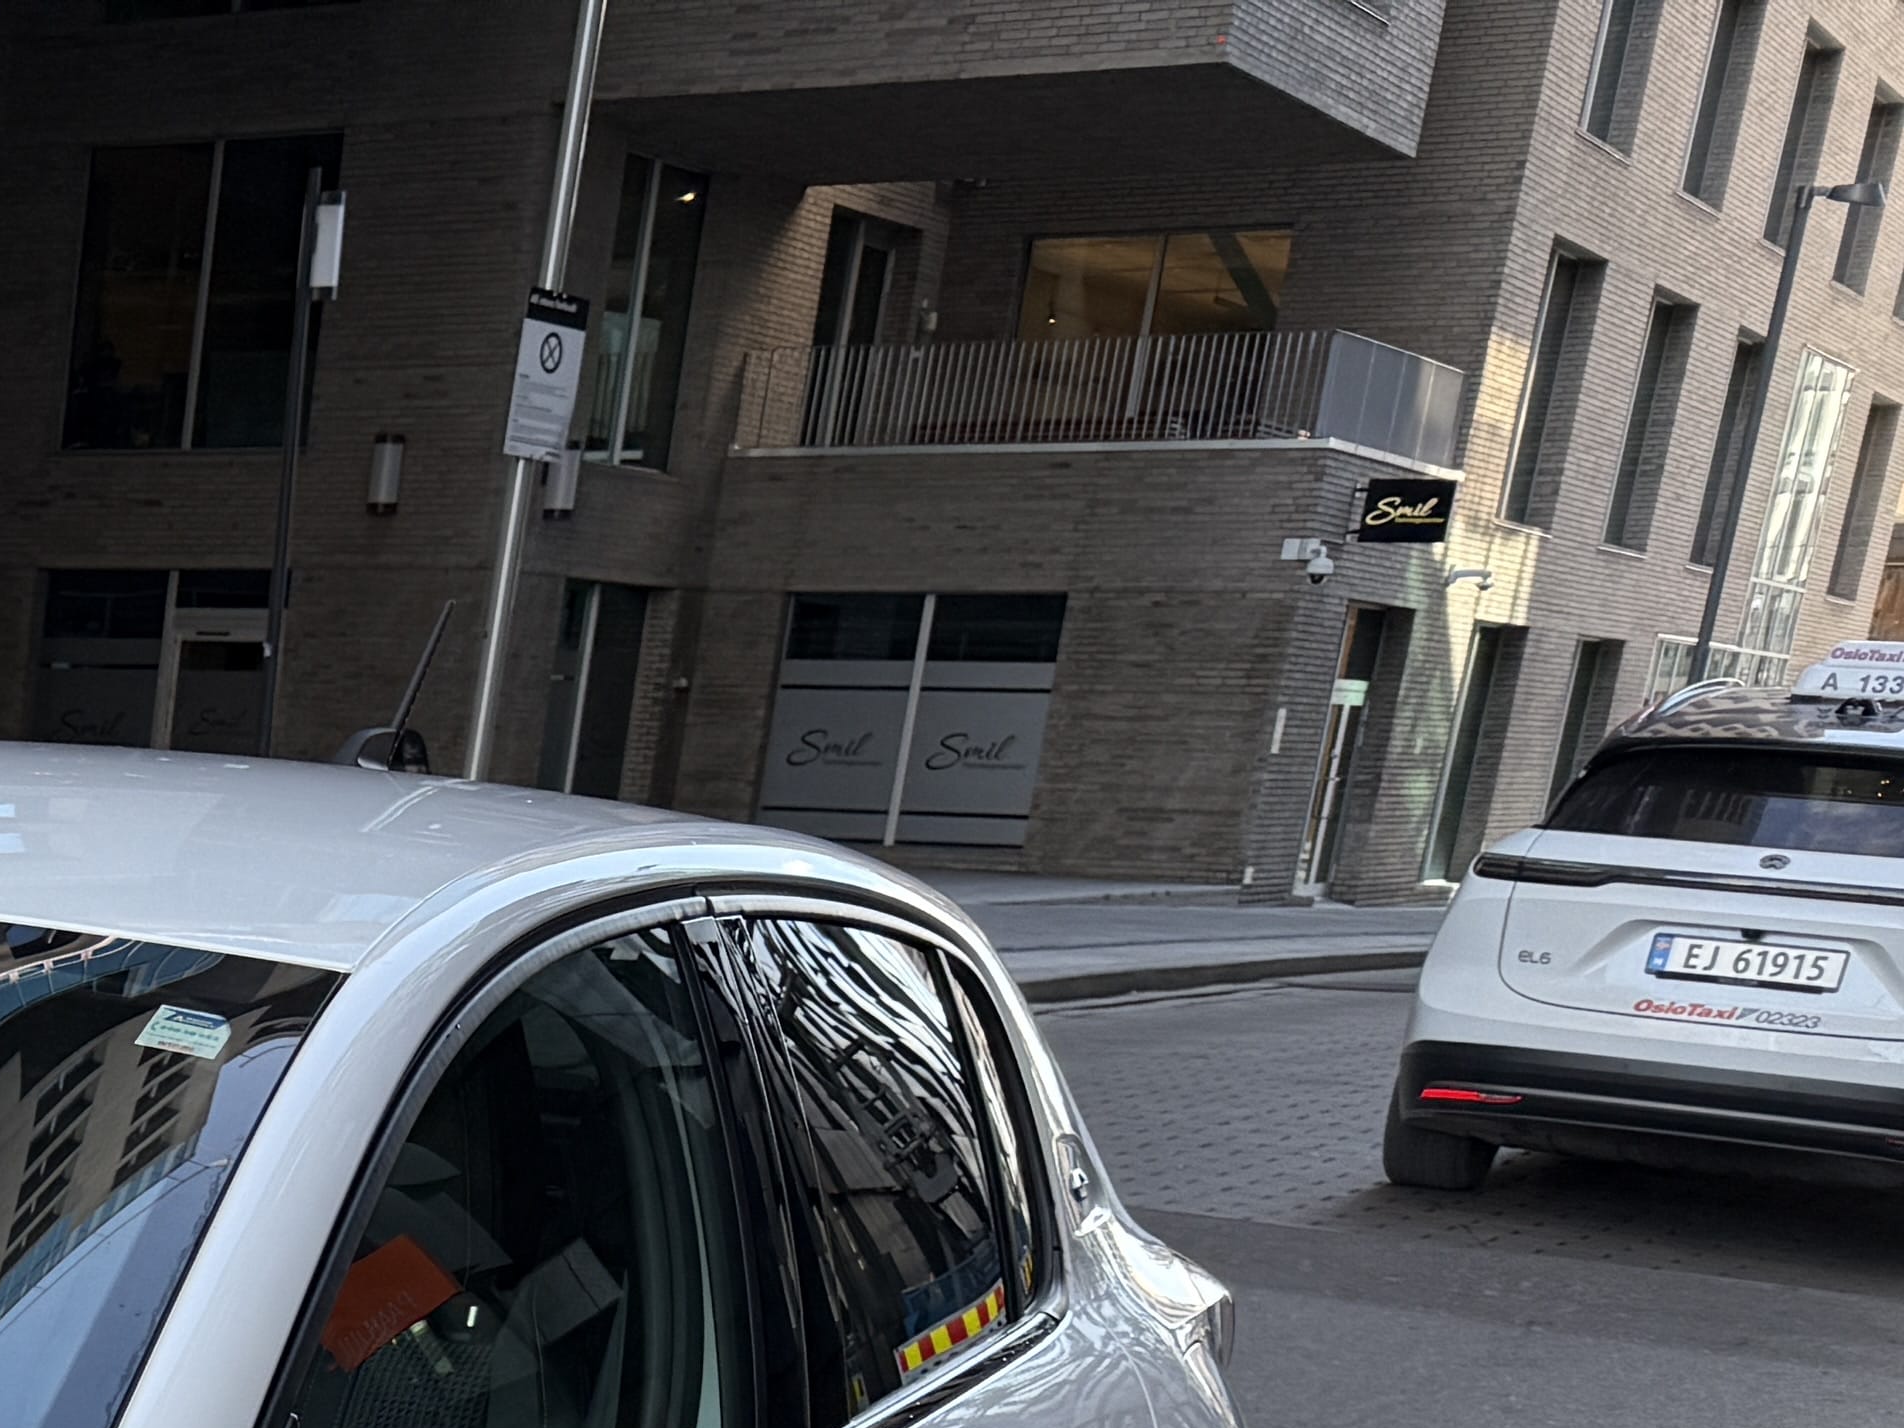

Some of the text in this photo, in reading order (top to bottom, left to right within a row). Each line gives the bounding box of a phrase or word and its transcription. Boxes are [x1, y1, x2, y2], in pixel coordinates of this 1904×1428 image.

[1365, 496, 1439, 526] Smil
[1821, 672, 1839, 691] A
[786, 729, 873, 766] Smil
[925, 733, 1016, 770] Smil
[1682, 943, 1829, 982] EJ 61915
[1754, 1010, 1822, 1029] 02323
